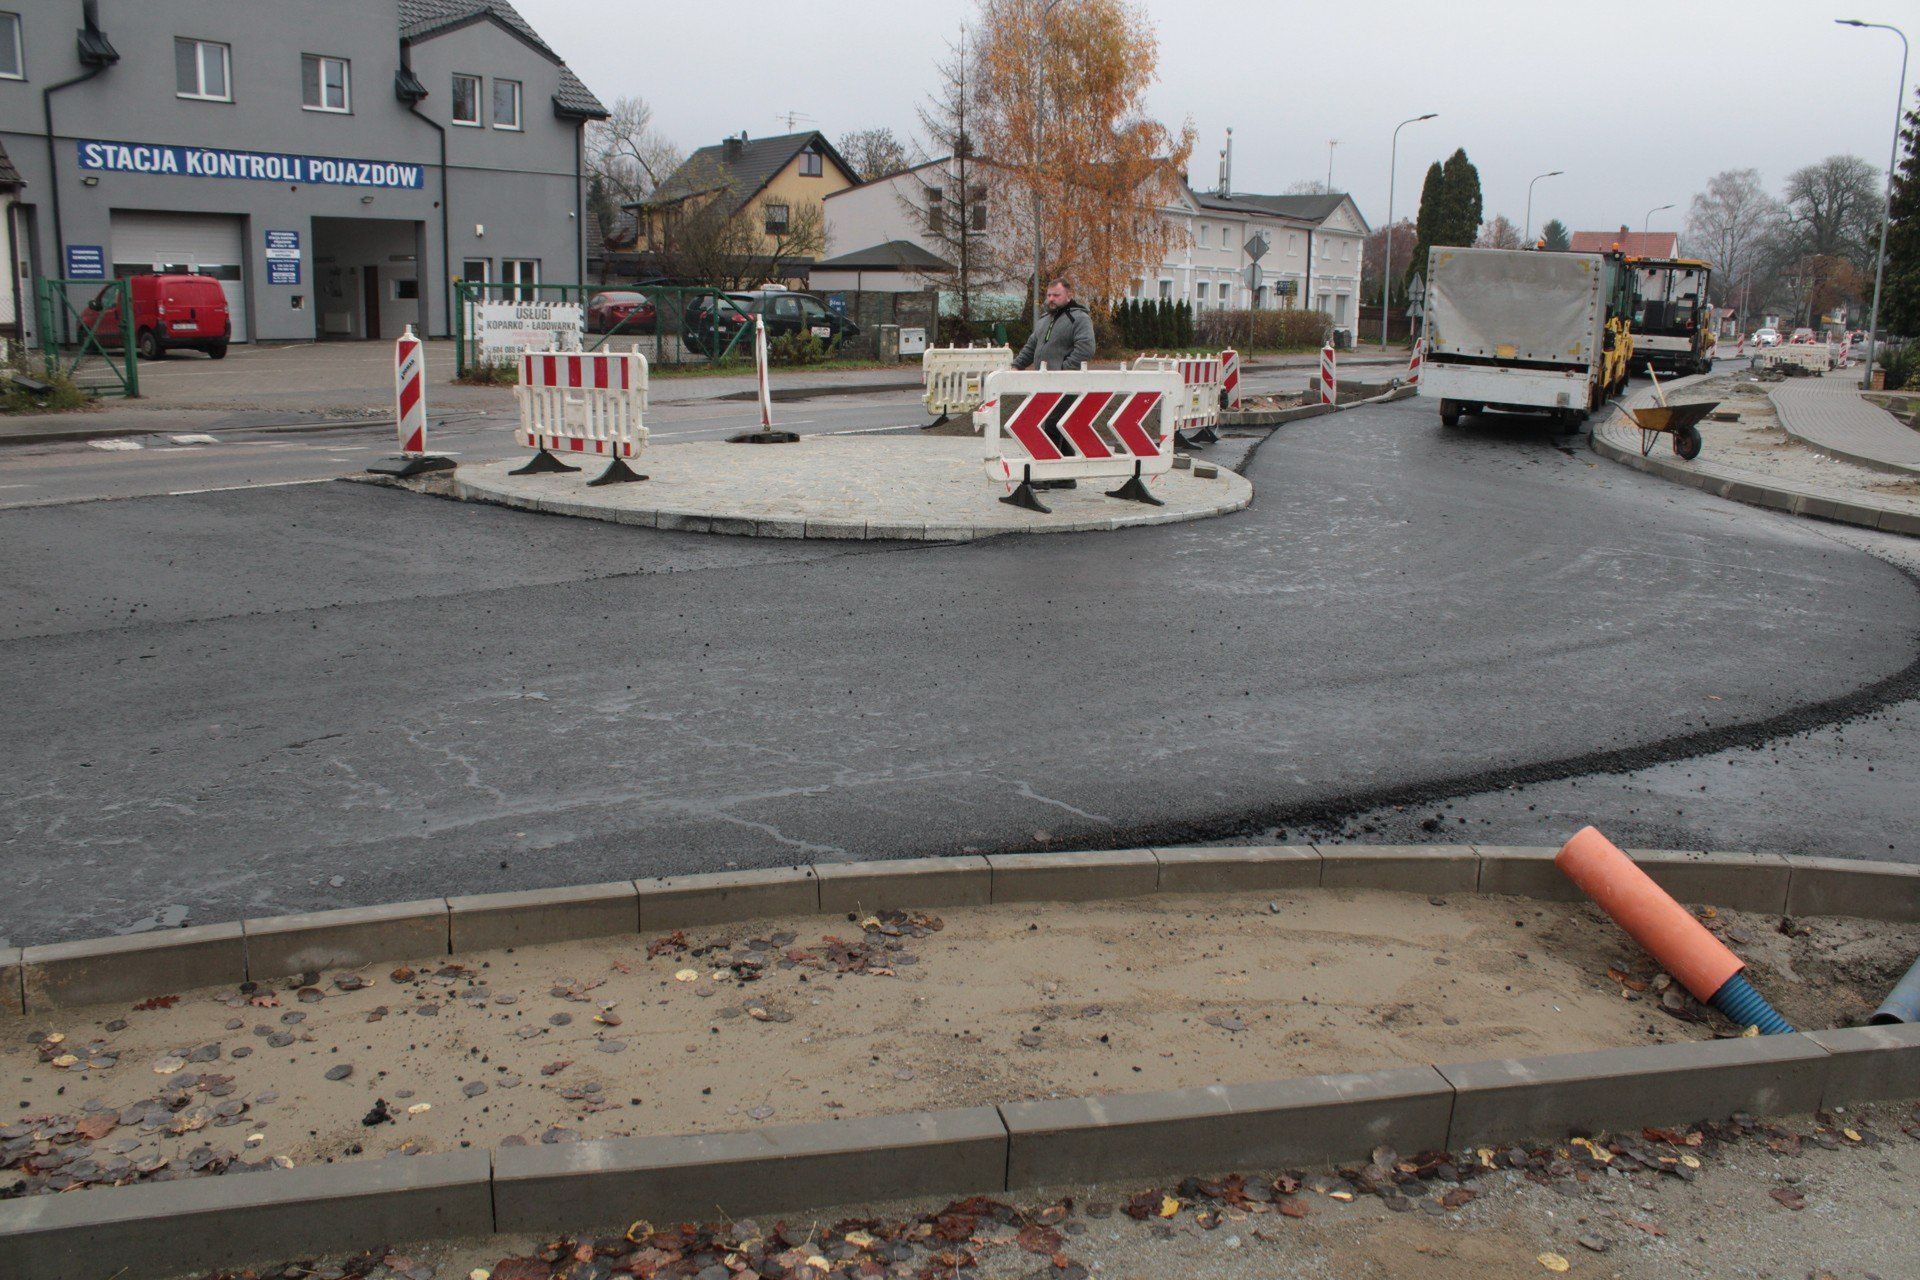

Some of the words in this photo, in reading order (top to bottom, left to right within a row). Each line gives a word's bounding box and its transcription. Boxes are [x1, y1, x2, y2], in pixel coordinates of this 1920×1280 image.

[84, 143, 178, 173] STACJA
[185, 150, 301, 180] KONTROLI
[309, 159, 417, 187] POJAZDÓW
[516, 307, 552, 320] USŁUGI
[486, 320, 524, 330] KOPARKO
[531, 321, 577, 331] ŁADOWARKA
